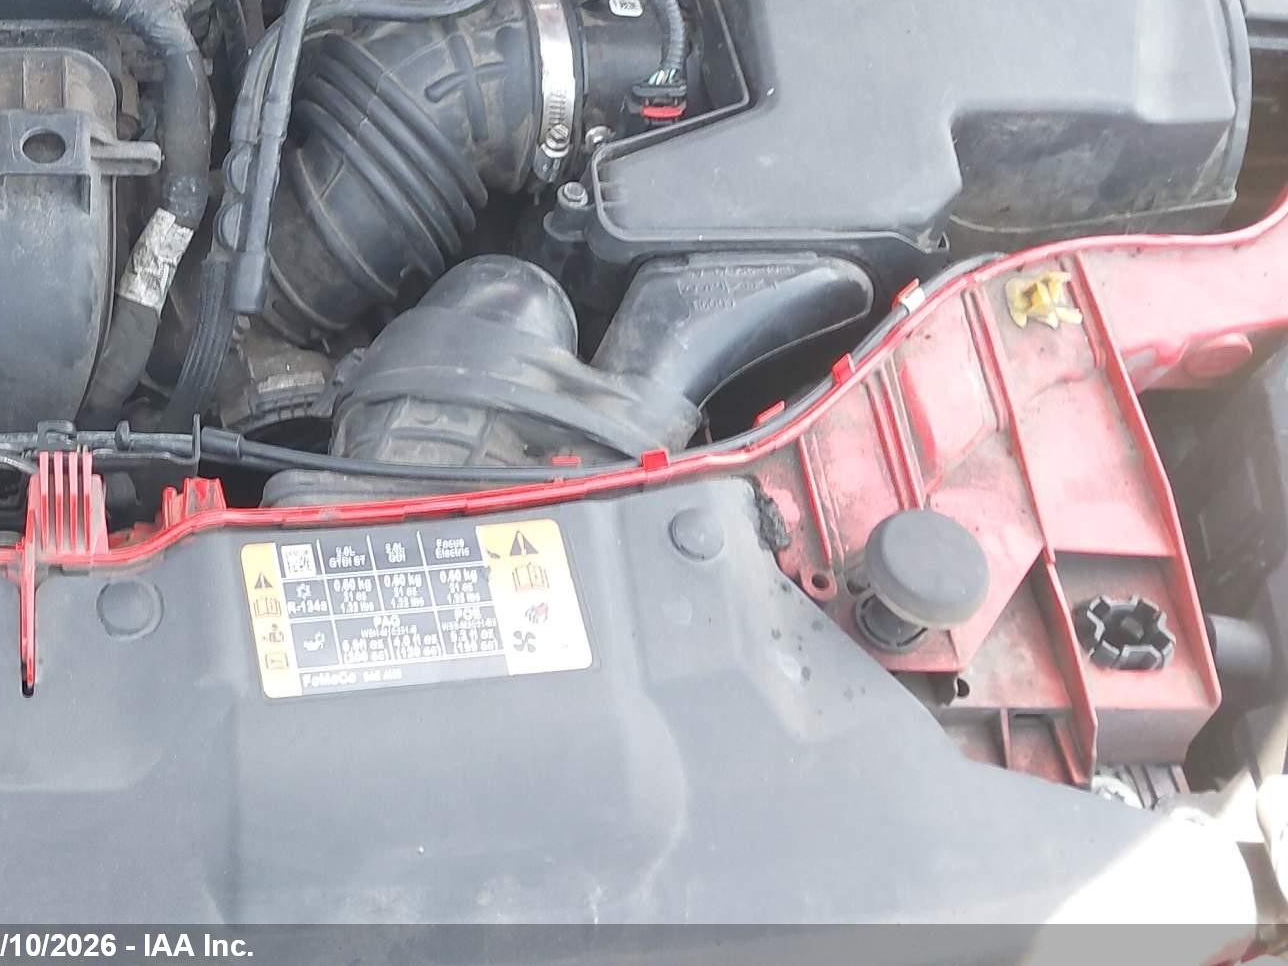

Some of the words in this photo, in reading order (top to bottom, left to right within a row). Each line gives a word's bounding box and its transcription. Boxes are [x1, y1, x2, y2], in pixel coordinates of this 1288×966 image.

[407, 572, 422, 587] kg
[462, 568, 478, 583] kg
[357, 577, 372, 592] kg
[287, 598, 328, 614] R-134a
[302, 671, 358, 688] FoMoCo
